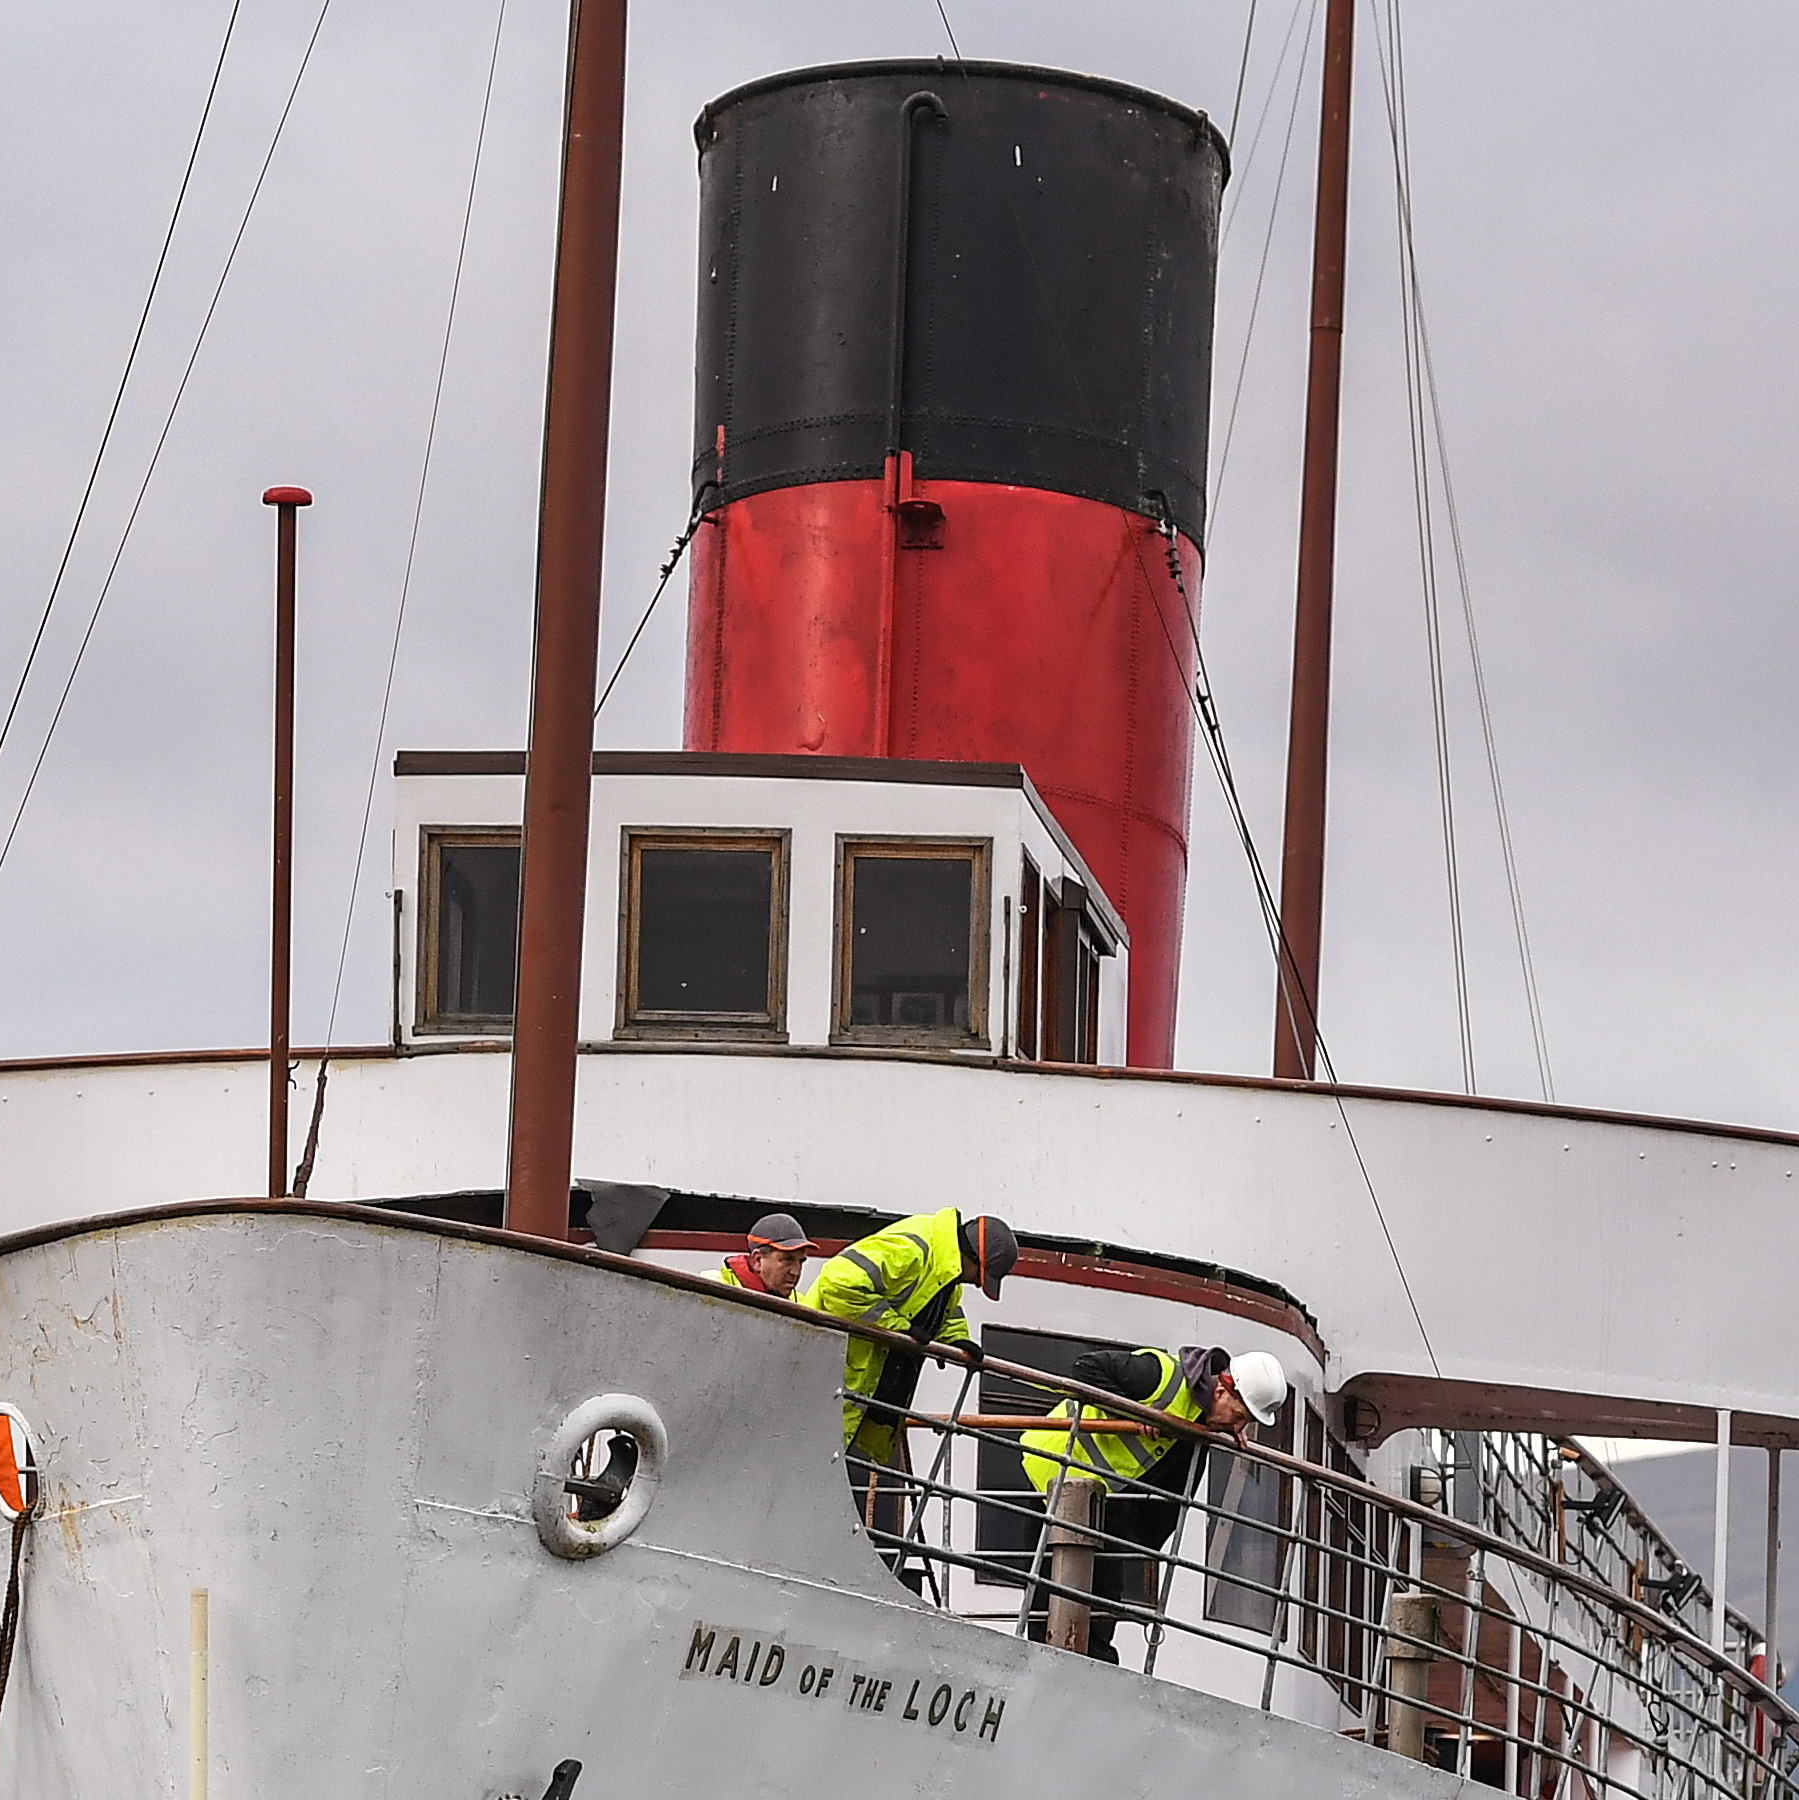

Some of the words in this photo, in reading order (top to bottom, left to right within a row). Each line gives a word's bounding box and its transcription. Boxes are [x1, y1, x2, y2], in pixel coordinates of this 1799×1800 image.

[685, 1628, 786, 1687] MAID
[799, 1665, 834, 1698] OF
[849, 1674, 893, 1712] THE
[902, 1679, 1006, 1743] LOCH
